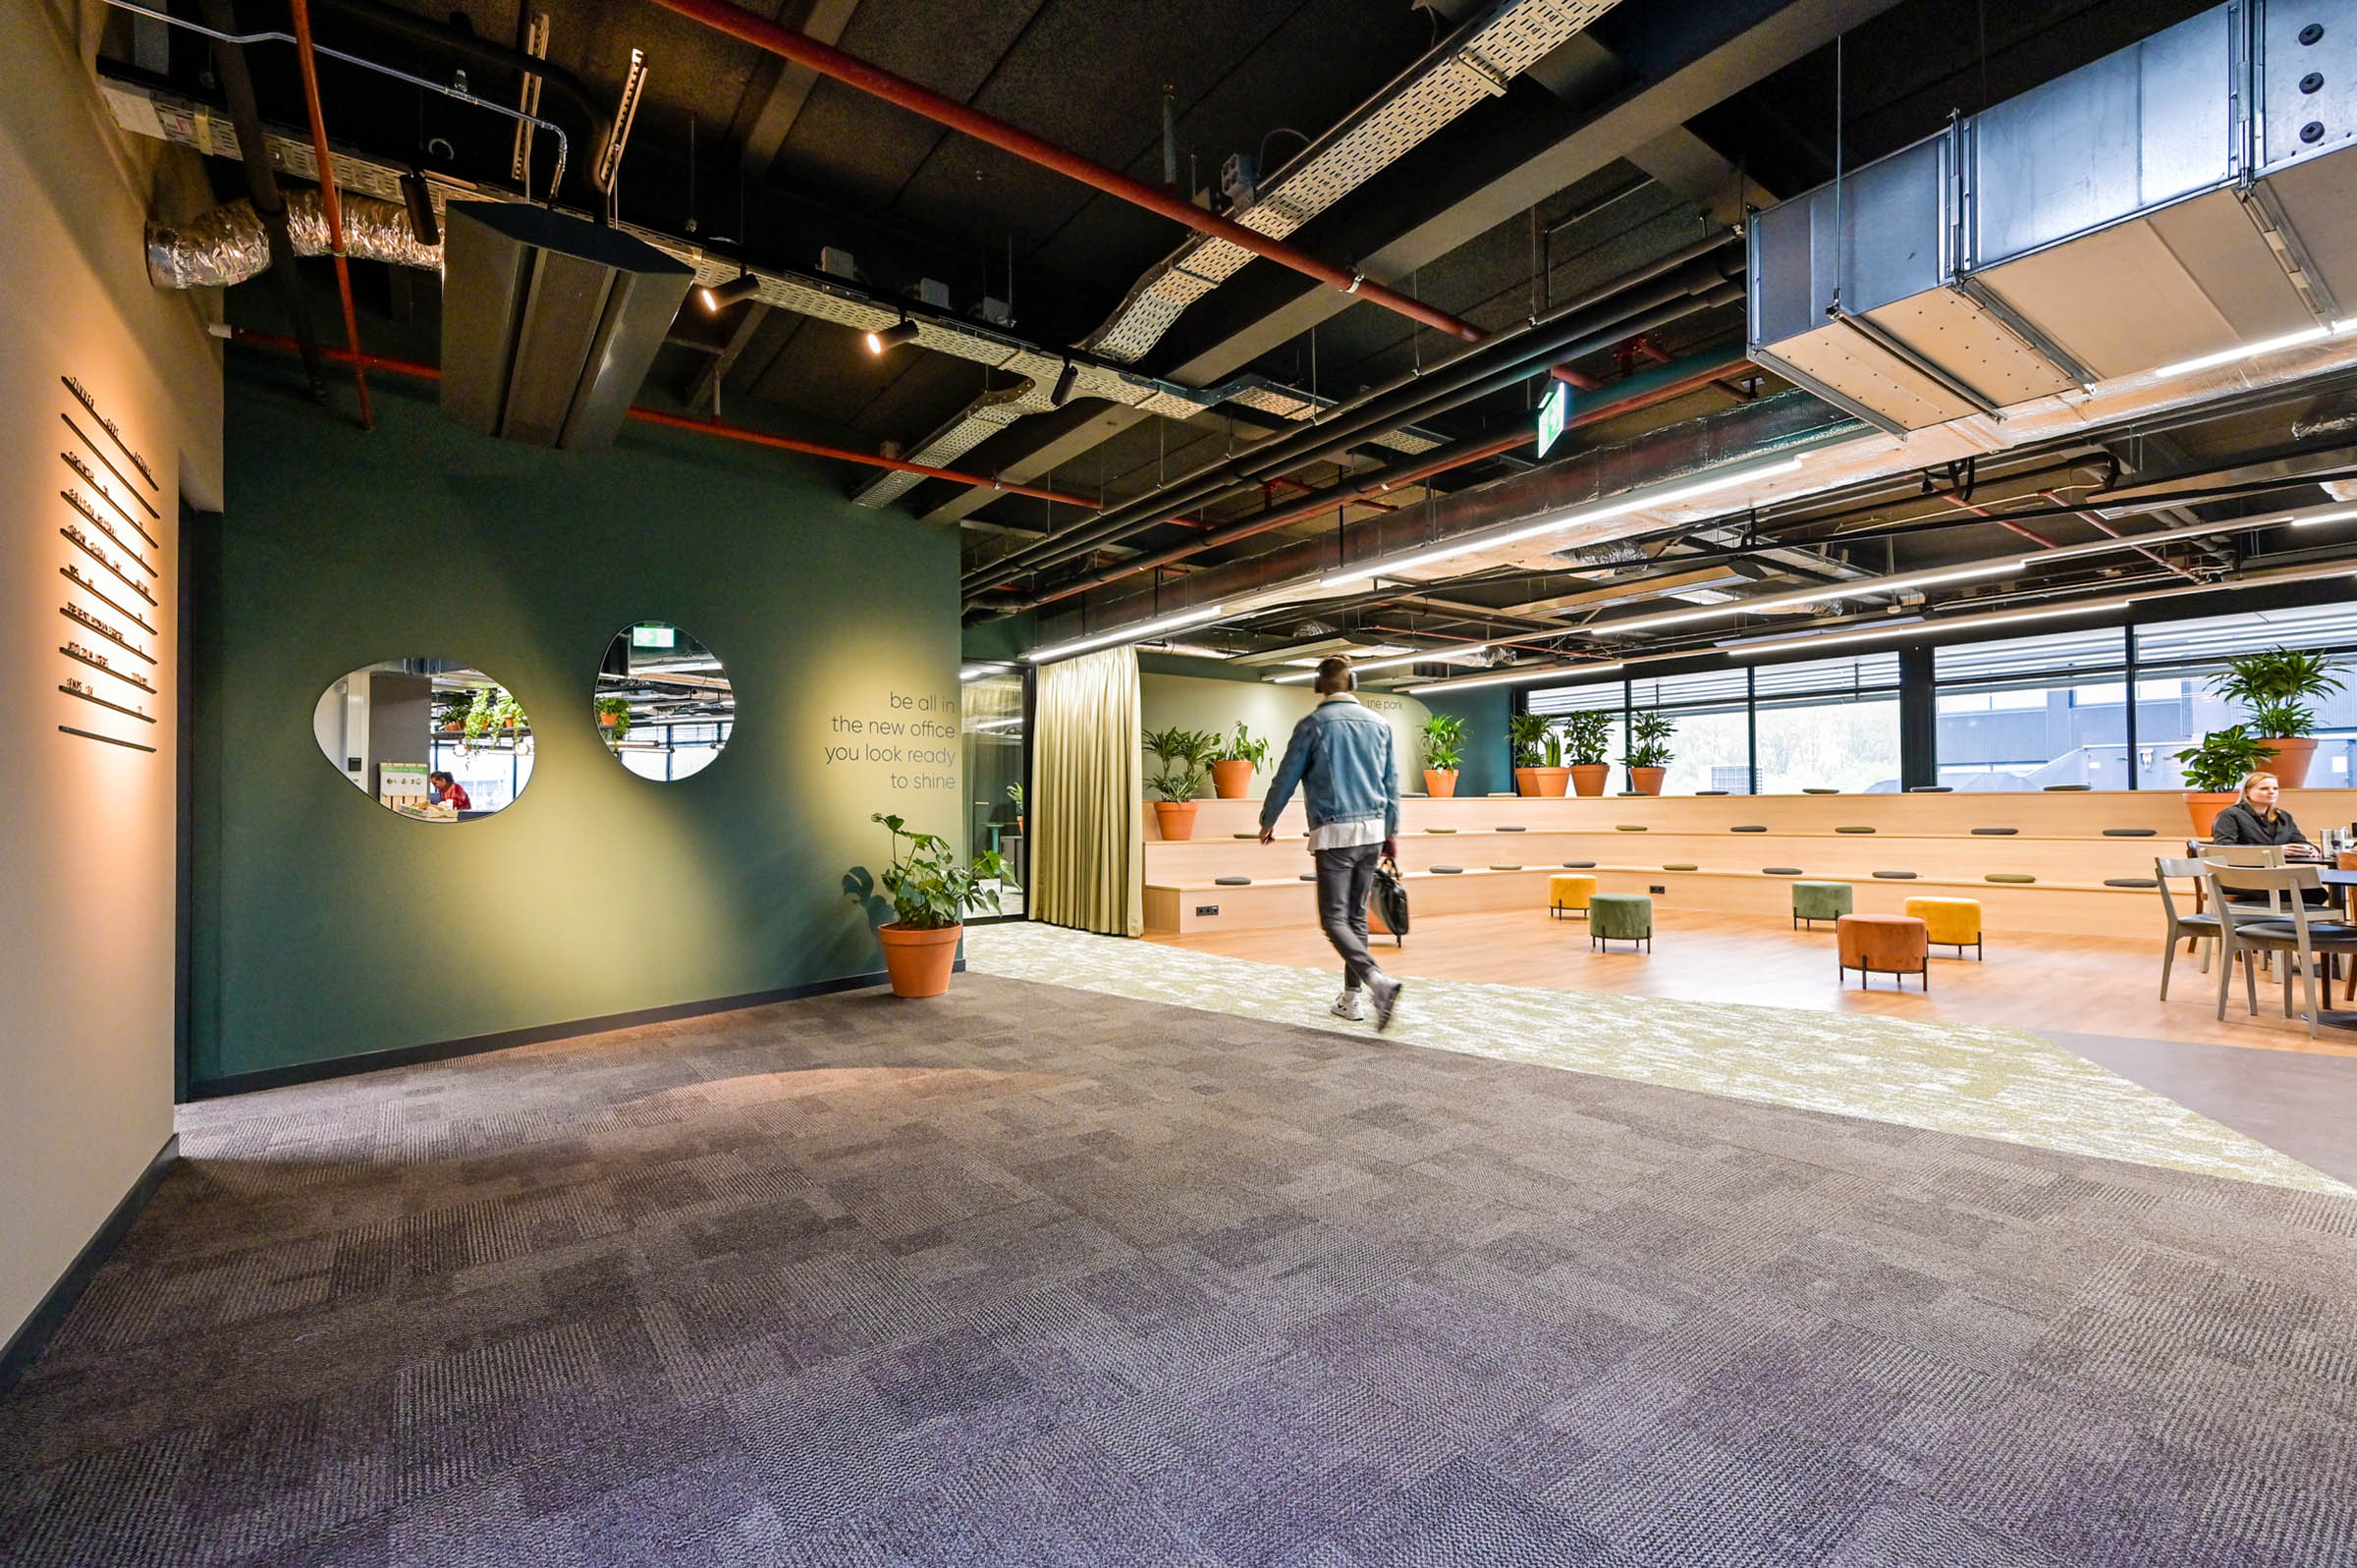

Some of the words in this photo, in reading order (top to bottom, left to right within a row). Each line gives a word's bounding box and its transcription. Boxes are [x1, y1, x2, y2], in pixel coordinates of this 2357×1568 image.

[890, 691, 913, 709] be
[917, 693, 937, 711] all
[942, 696, 956, 714] in
[1384, 698, 1403, 712] park
[831, 715, 863, 733] the
[869, 720, 905, 735] new
[910, 720, 956, 738] office
[825, 746, 859, 765] you
[865, 743, 903, 762] look
[907, 745, 957, 767] ready
[891, 773, 908, 789] to
[913, 770, 957, 789] shine
